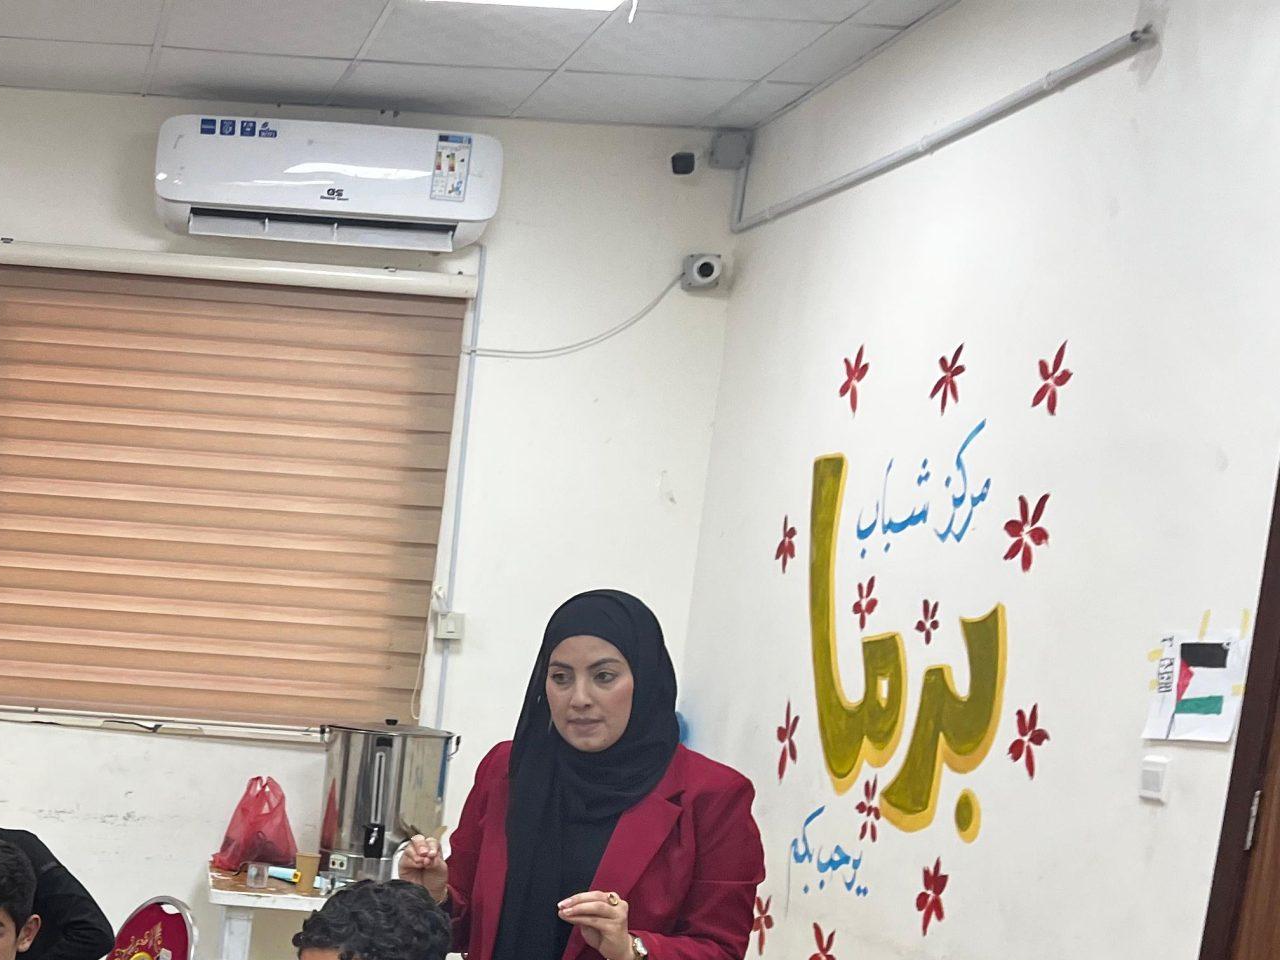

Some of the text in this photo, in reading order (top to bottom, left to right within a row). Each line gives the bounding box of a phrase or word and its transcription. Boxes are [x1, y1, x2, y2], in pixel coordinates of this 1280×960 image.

[856, 417, 992, 559] مركز شباب
[809, 452, 1008, 844] برما
[785, 805, 869, 919] يرحب بكم
